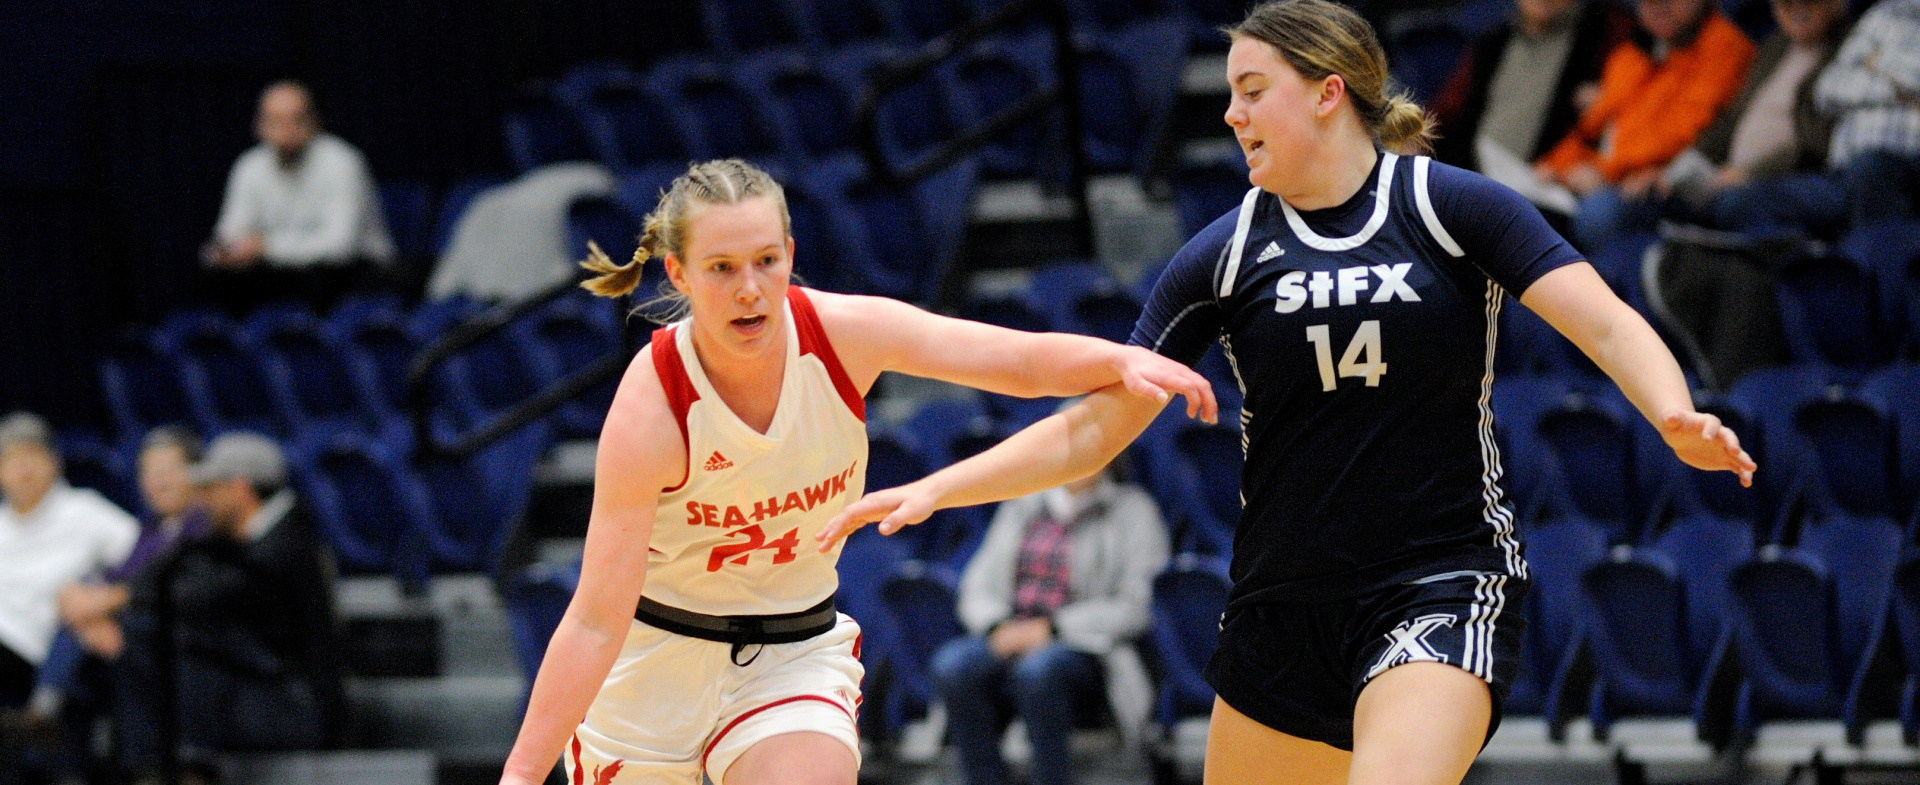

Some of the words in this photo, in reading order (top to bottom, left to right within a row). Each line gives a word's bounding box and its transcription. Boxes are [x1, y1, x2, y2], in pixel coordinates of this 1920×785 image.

[1274, 262, 1422, 314] StFX
[1306, 320, 1388, 392] 14
[704, 461, 734, 471] adidas
[706, 524, 800, 573] 24
